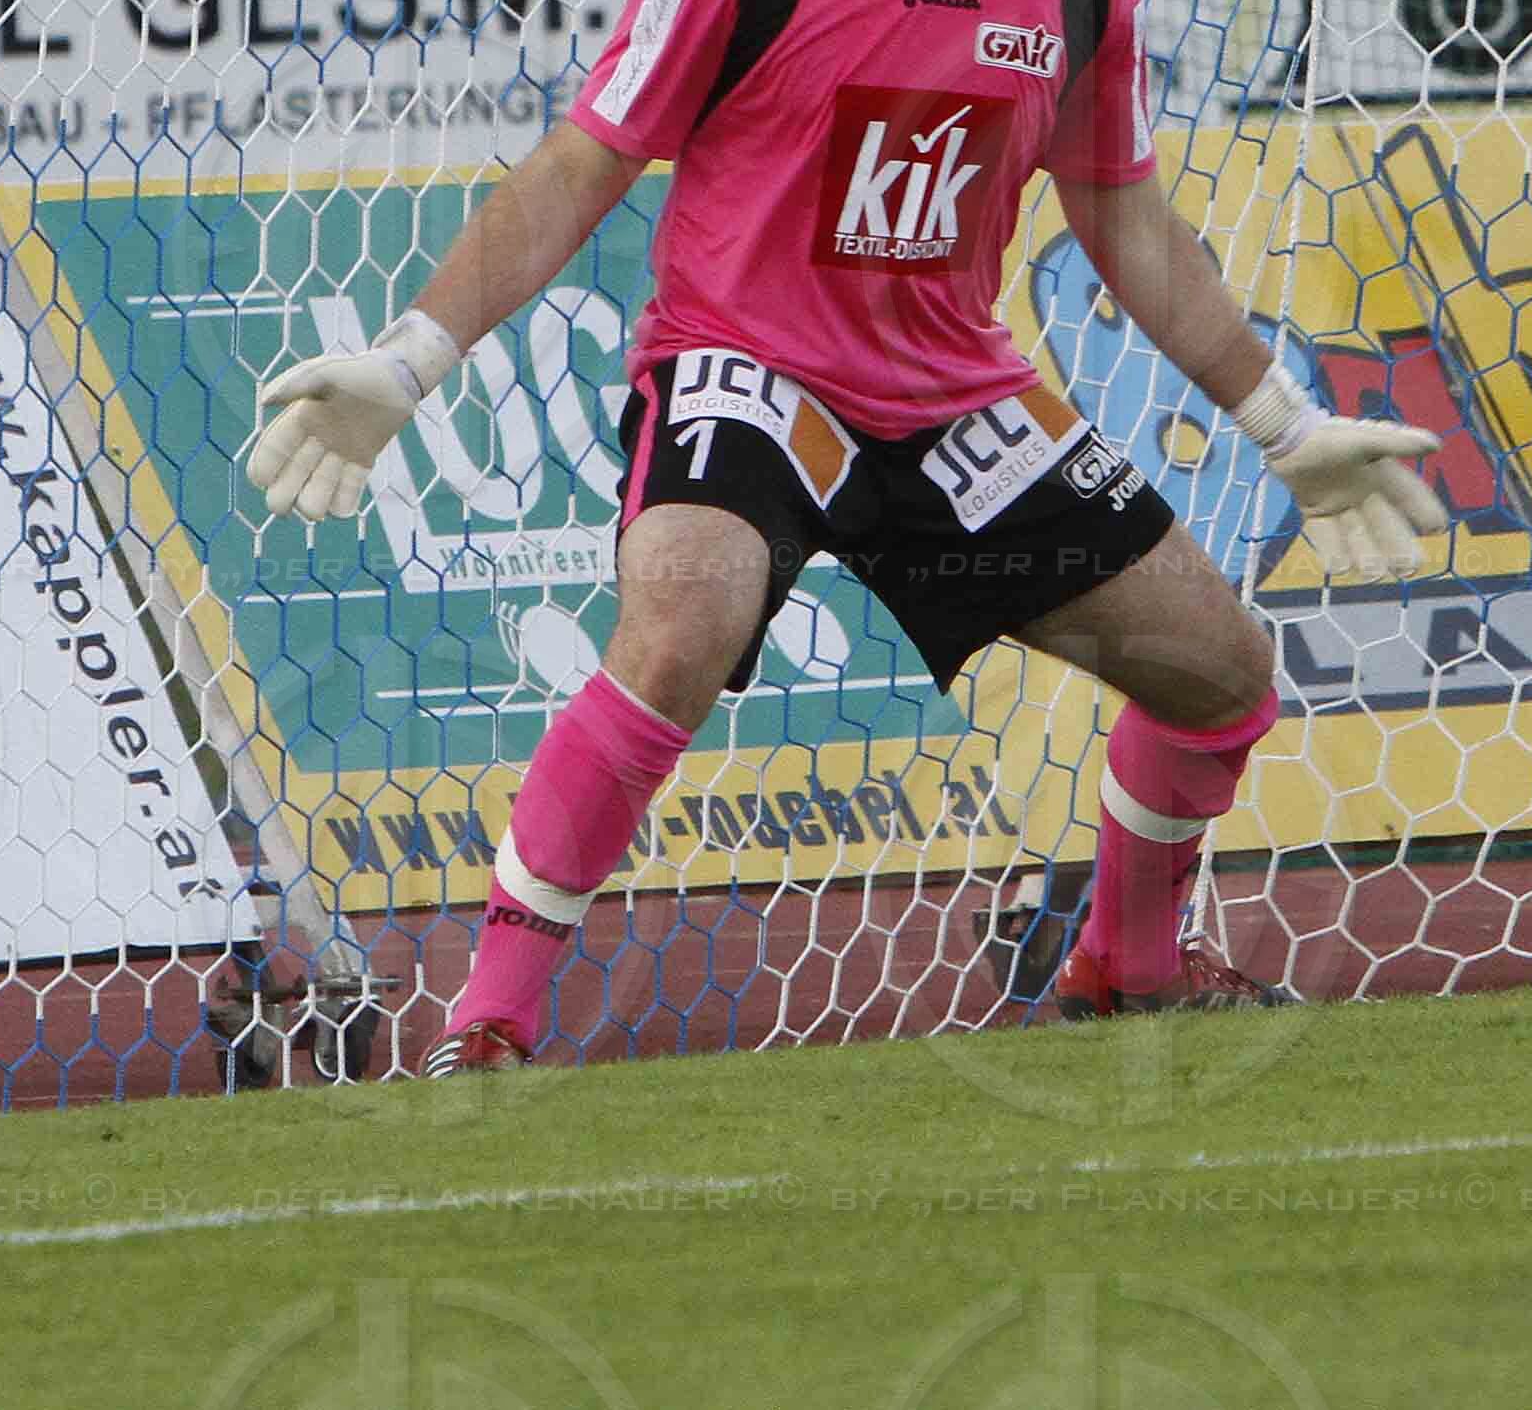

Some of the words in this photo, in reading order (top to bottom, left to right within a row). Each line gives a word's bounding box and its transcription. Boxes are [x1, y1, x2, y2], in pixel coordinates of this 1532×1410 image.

[980, 24, 1057, 74] GAK
[837, 106, 982, 241] kik
[679, 354, 786, 421] JCL
[674, 419, 718, 480] 1
[936, 404, 1031, 500] JCL
